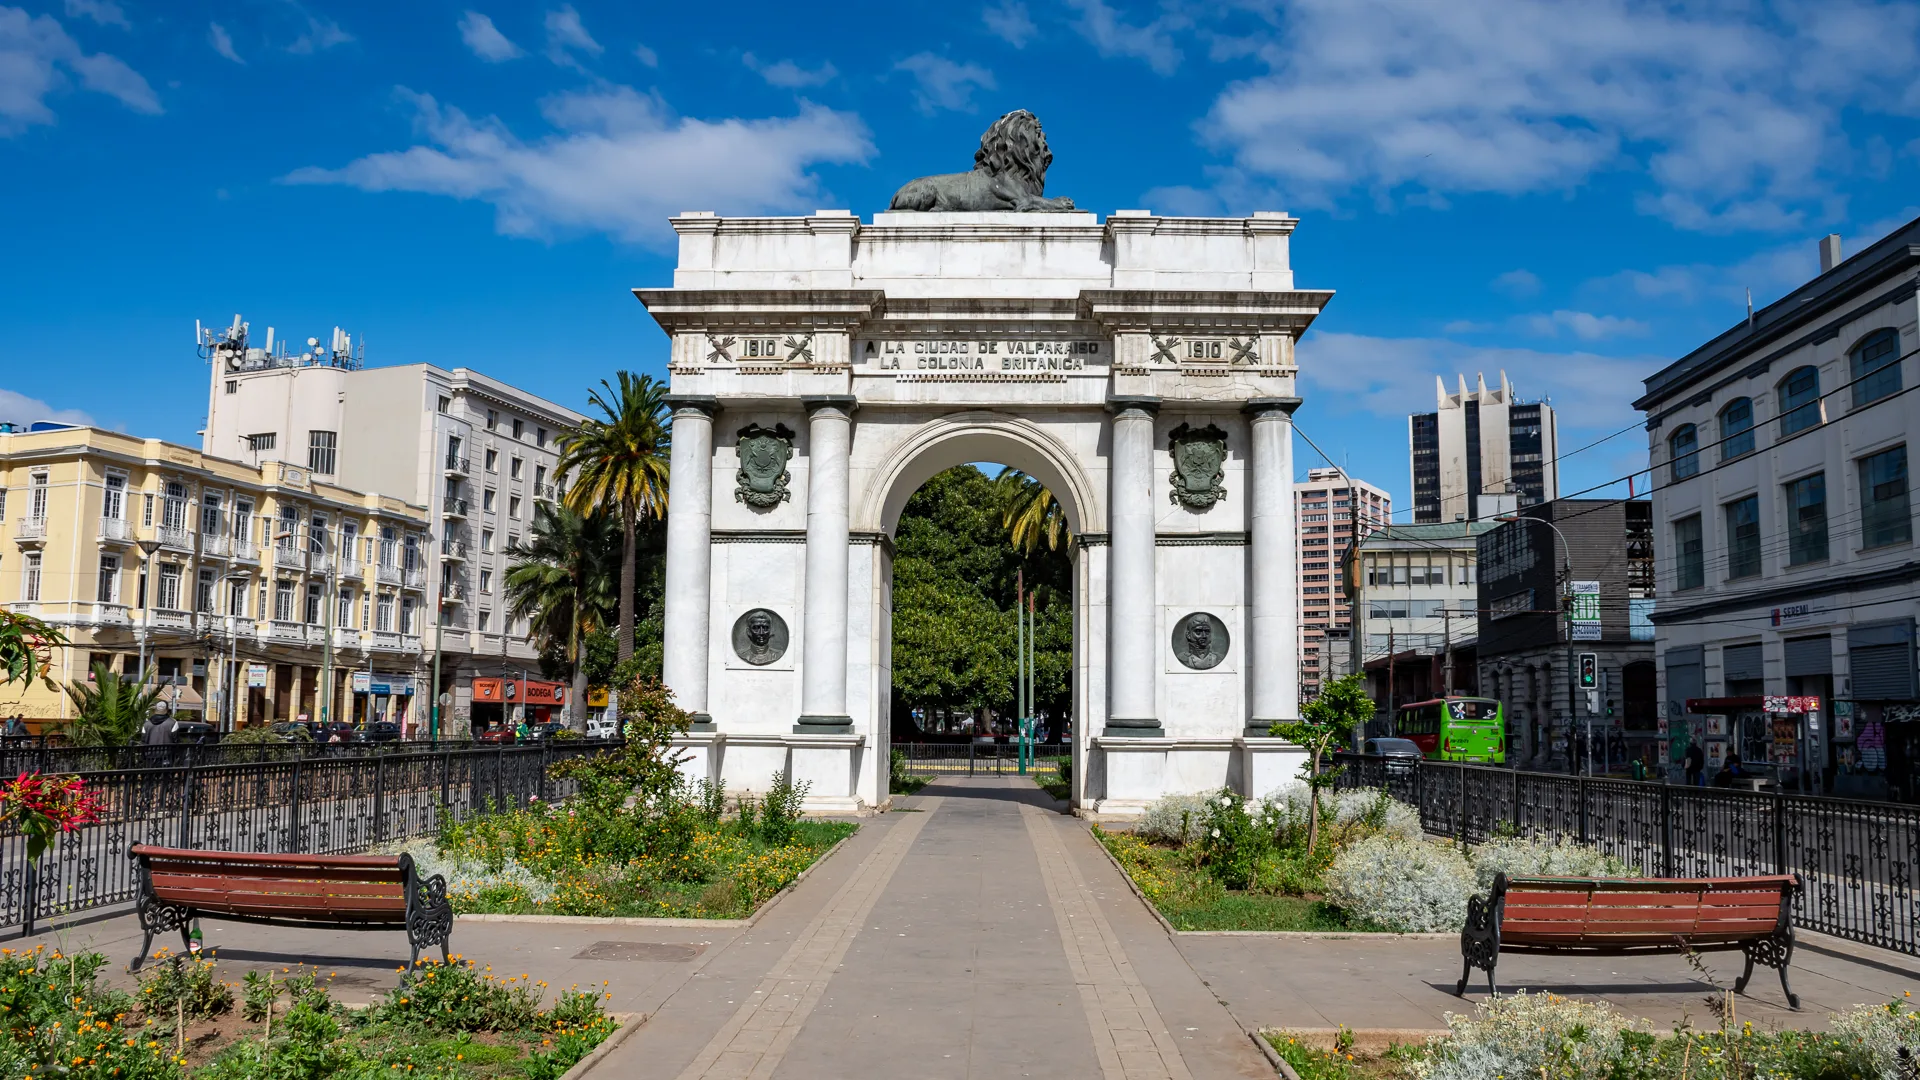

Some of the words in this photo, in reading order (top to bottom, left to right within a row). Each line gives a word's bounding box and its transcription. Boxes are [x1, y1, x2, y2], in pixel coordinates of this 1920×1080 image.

[865, 341, 876, 353] A
[885, 341, 905, 354] LA
[914, 341, 969, 354] CIUDAD
[978, 341, 998, 354] DE
[1006, 341, 1099, 355] VALPARAISO
[1187, 341, 1221, 358] 1910
[880, 357, 900, 370] LA
[917, 357, 984, 370] COLONIA
[1001, 357, 1083, 370] BRITANICA
[1783, 604, 1809, 618] SEREMI
[527, 687, 552, 698] BODEGA
